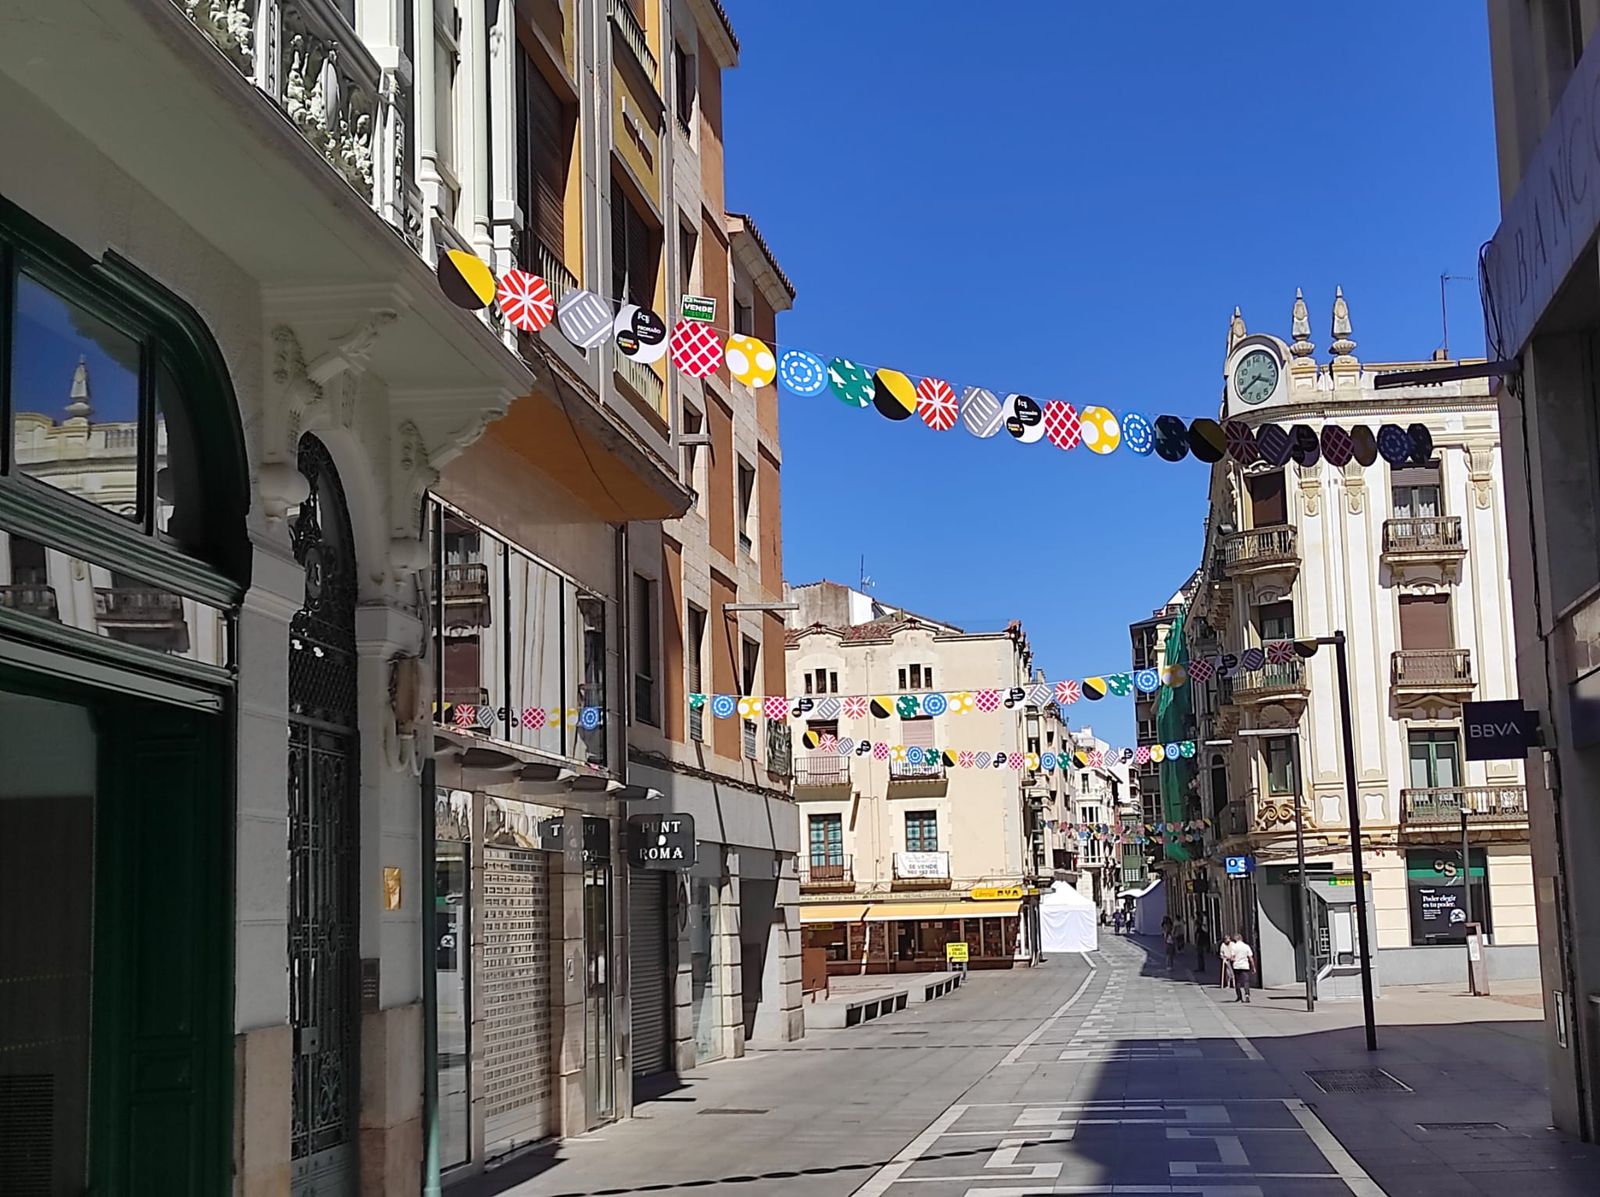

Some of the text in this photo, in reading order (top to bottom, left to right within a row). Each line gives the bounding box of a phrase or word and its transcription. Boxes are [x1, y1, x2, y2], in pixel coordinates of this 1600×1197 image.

[684, 303, 713, 314] VENDE
[1470, 721, 1521, 738] BBVA
[641, 821, 681, 833] PUNT
[640, 847, 684, 860] ROMA
